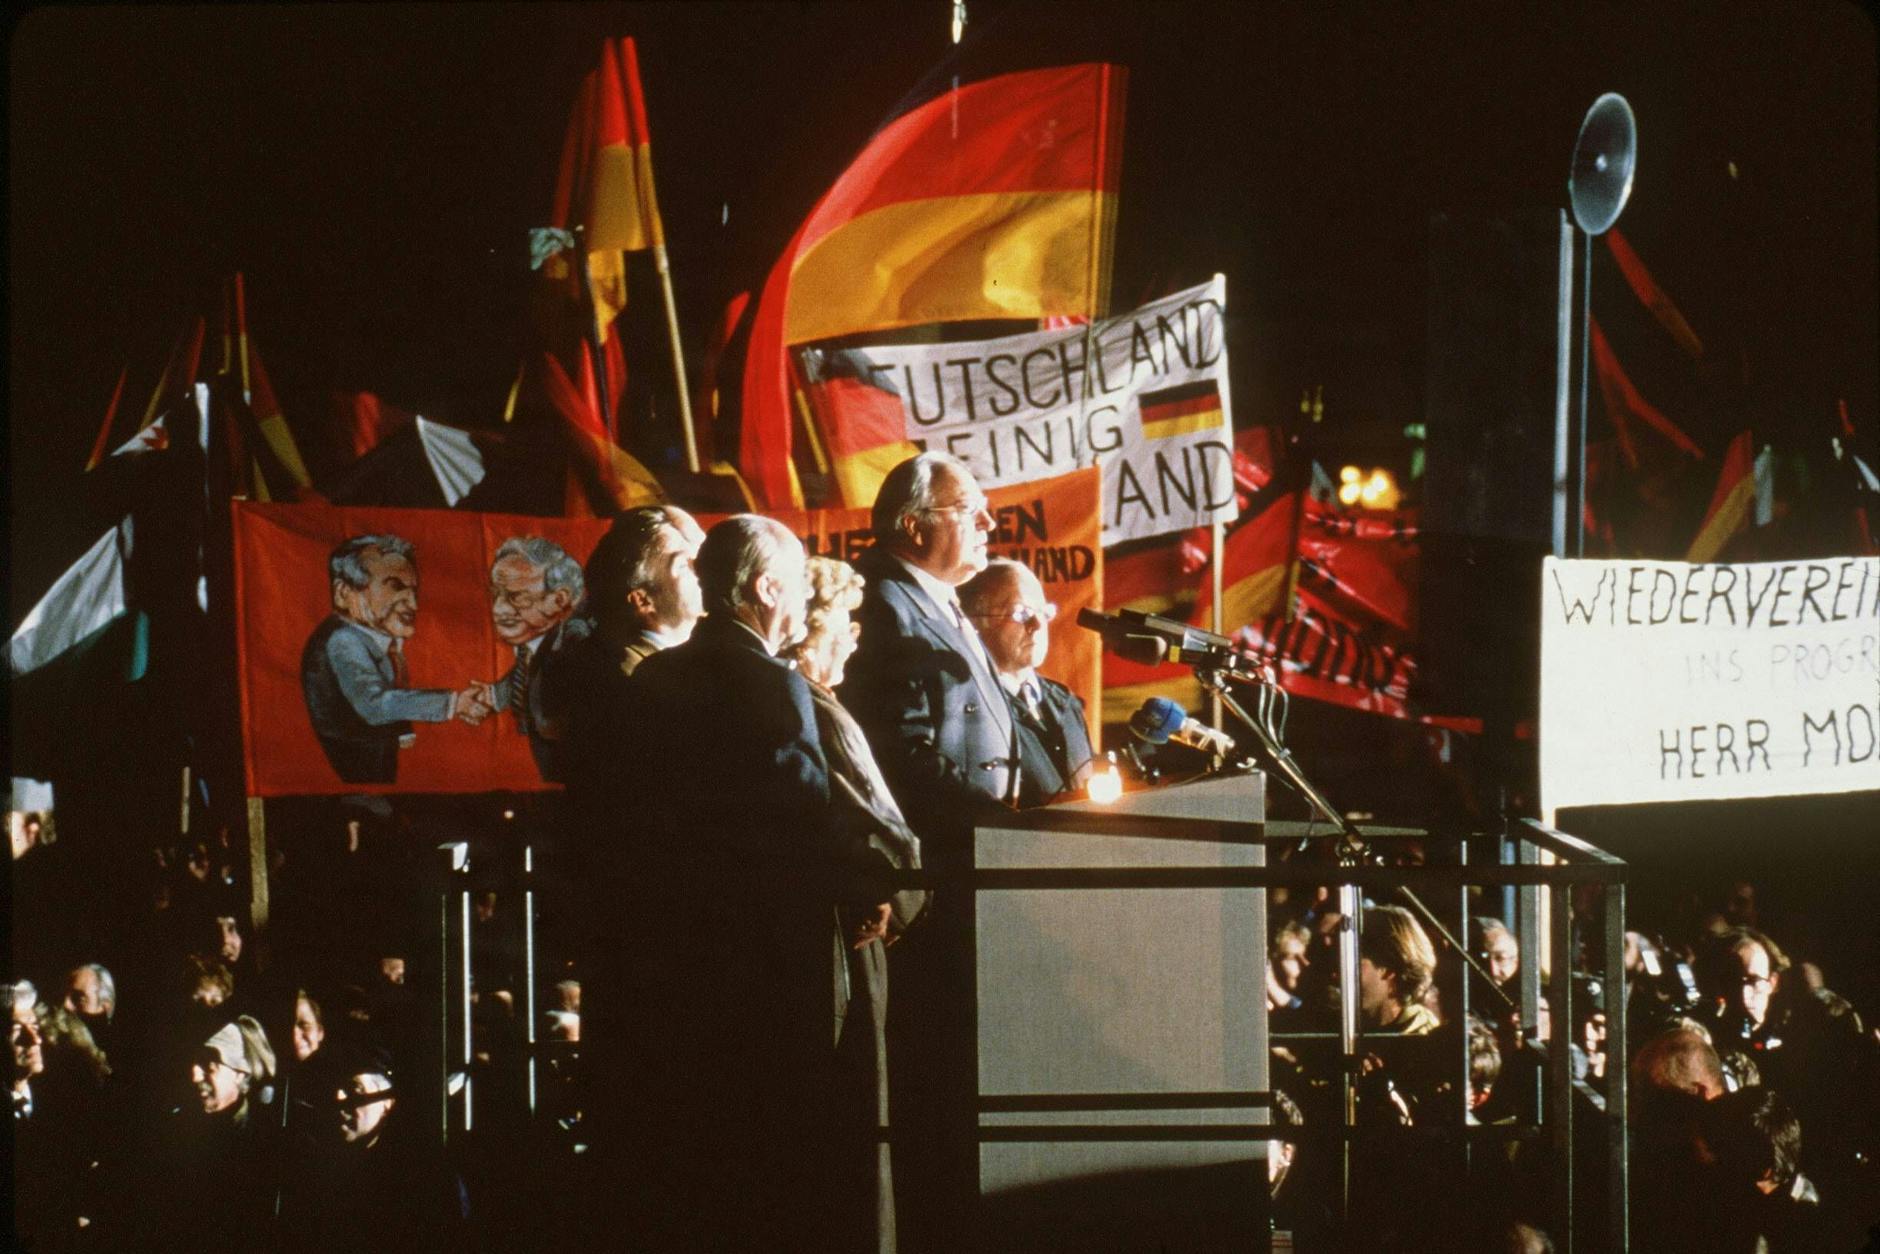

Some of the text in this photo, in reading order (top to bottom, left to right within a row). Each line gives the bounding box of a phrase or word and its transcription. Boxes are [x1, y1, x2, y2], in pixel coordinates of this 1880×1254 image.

[868, 298, 1225, 426] UTSCHLAND
[1101, 440, 1233, 531] AND
[1552, 561, 1880, 629] WIEDERVEREI
[1685, 648, 1743, 684] INS
[1659, 703, 1880, 780] HERR MO
